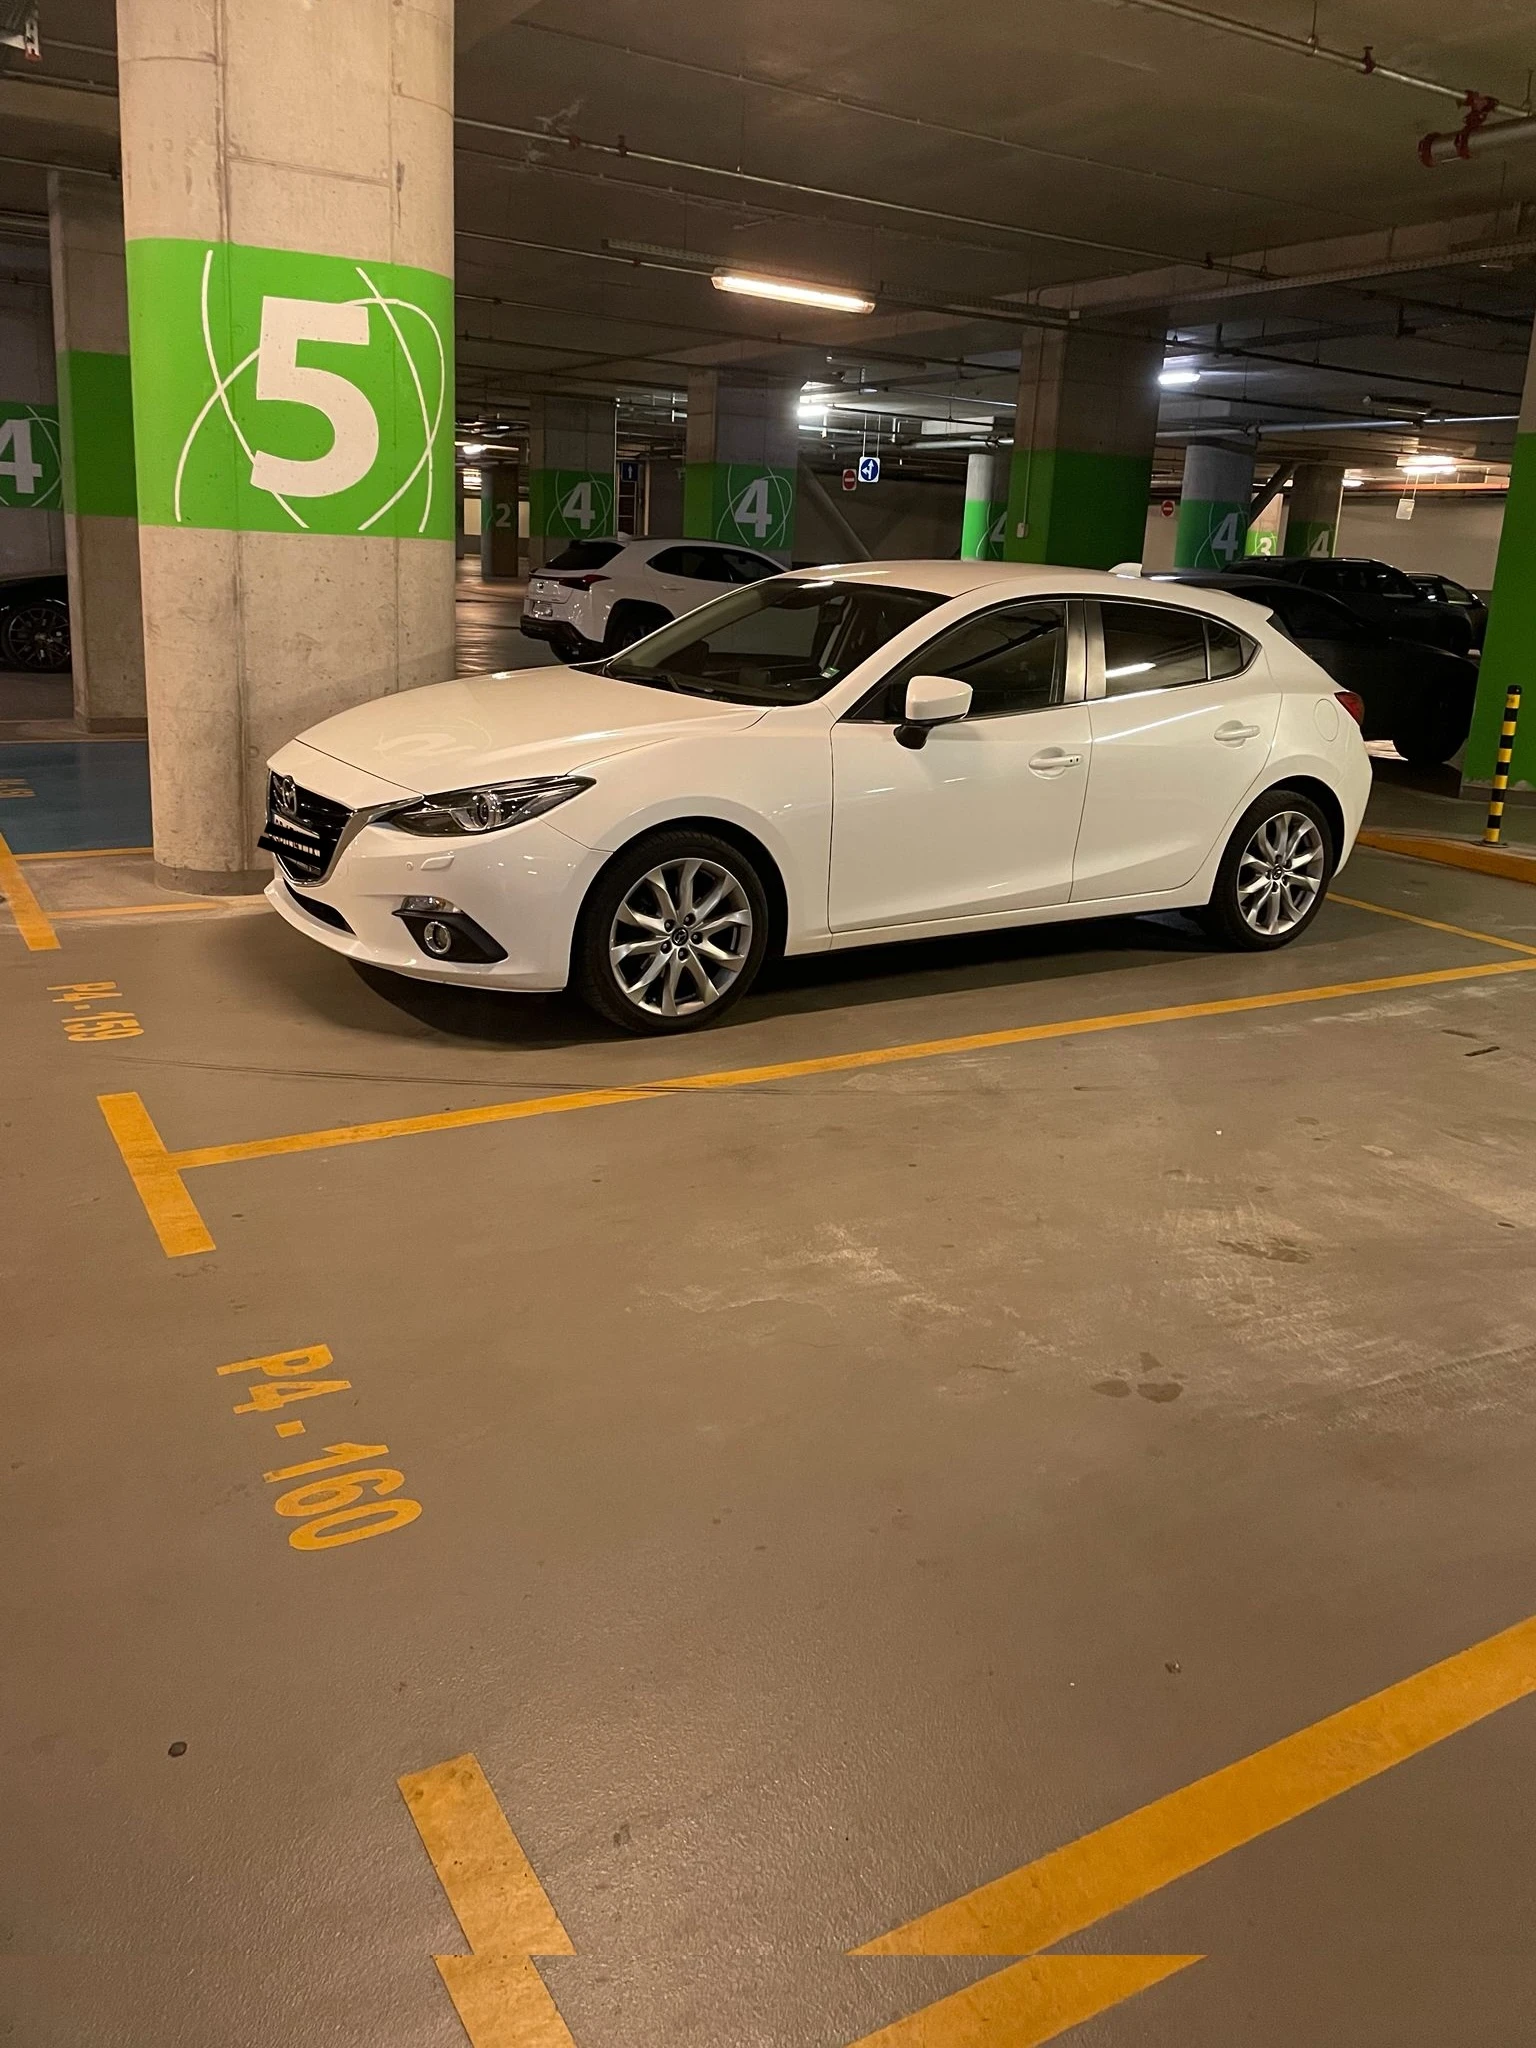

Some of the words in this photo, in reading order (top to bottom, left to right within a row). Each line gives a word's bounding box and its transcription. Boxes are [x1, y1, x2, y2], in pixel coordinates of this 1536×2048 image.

[250, 296, 379, 497] 5
[0, 419, 43, 494] 4
[495, 503, 512, 528] 2
[562, 482, 596, 530] 4
[734, 479, 773, 538] 4
[1211, 513, 1239, 560] 4
[216, 1344, 422, 1550] P4-160
